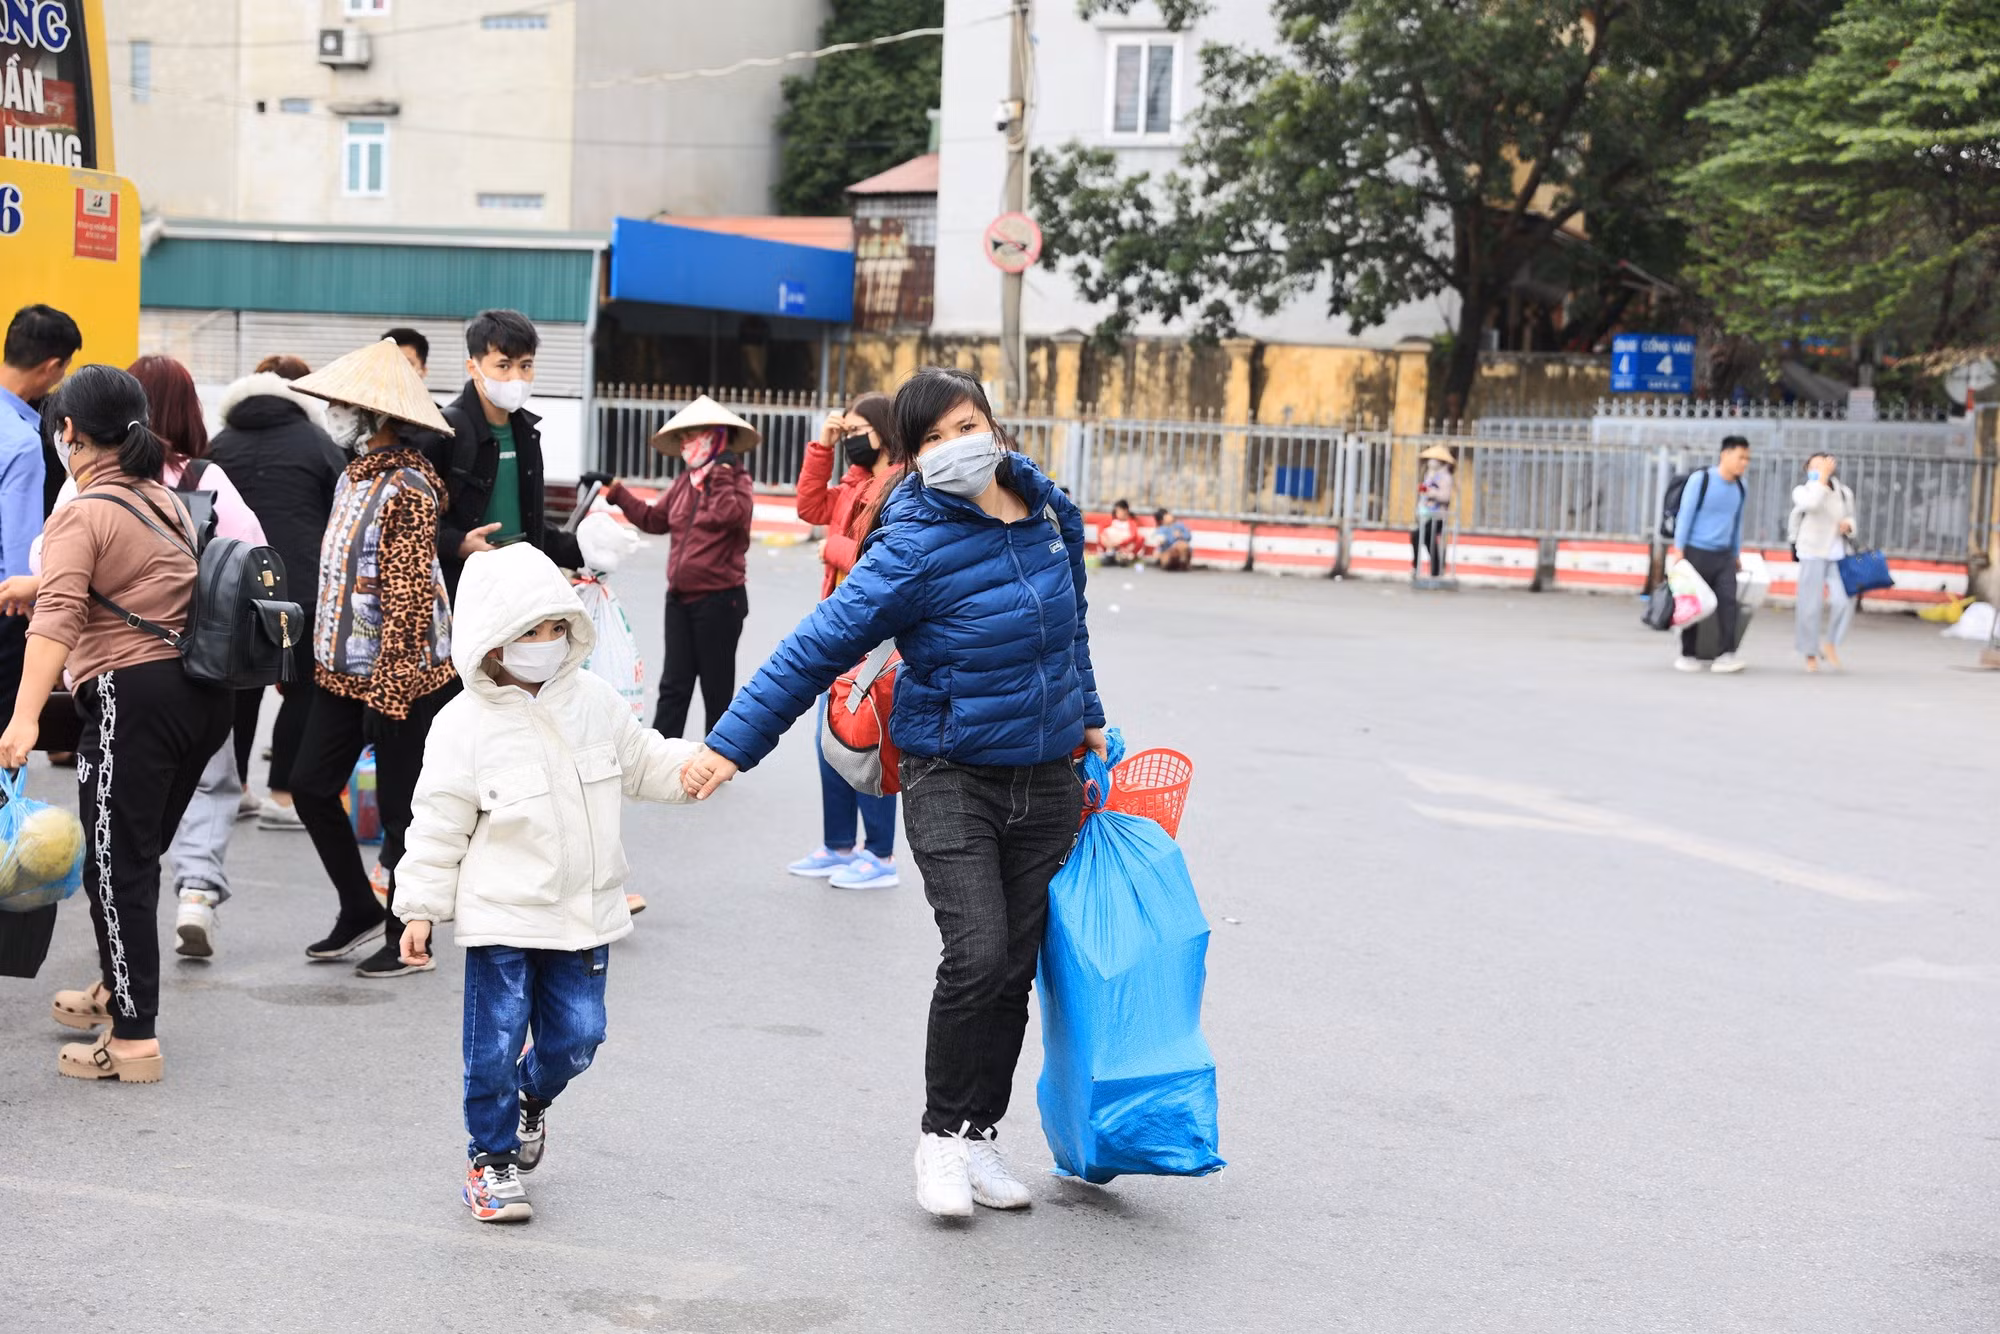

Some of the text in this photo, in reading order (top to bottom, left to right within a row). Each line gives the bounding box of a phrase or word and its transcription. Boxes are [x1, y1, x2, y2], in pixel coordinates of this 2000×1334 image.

[0, 0, 71, 52] NG
[0, 53, 44, 114] ẦN
[1655, 354, 1673, 375] 4
